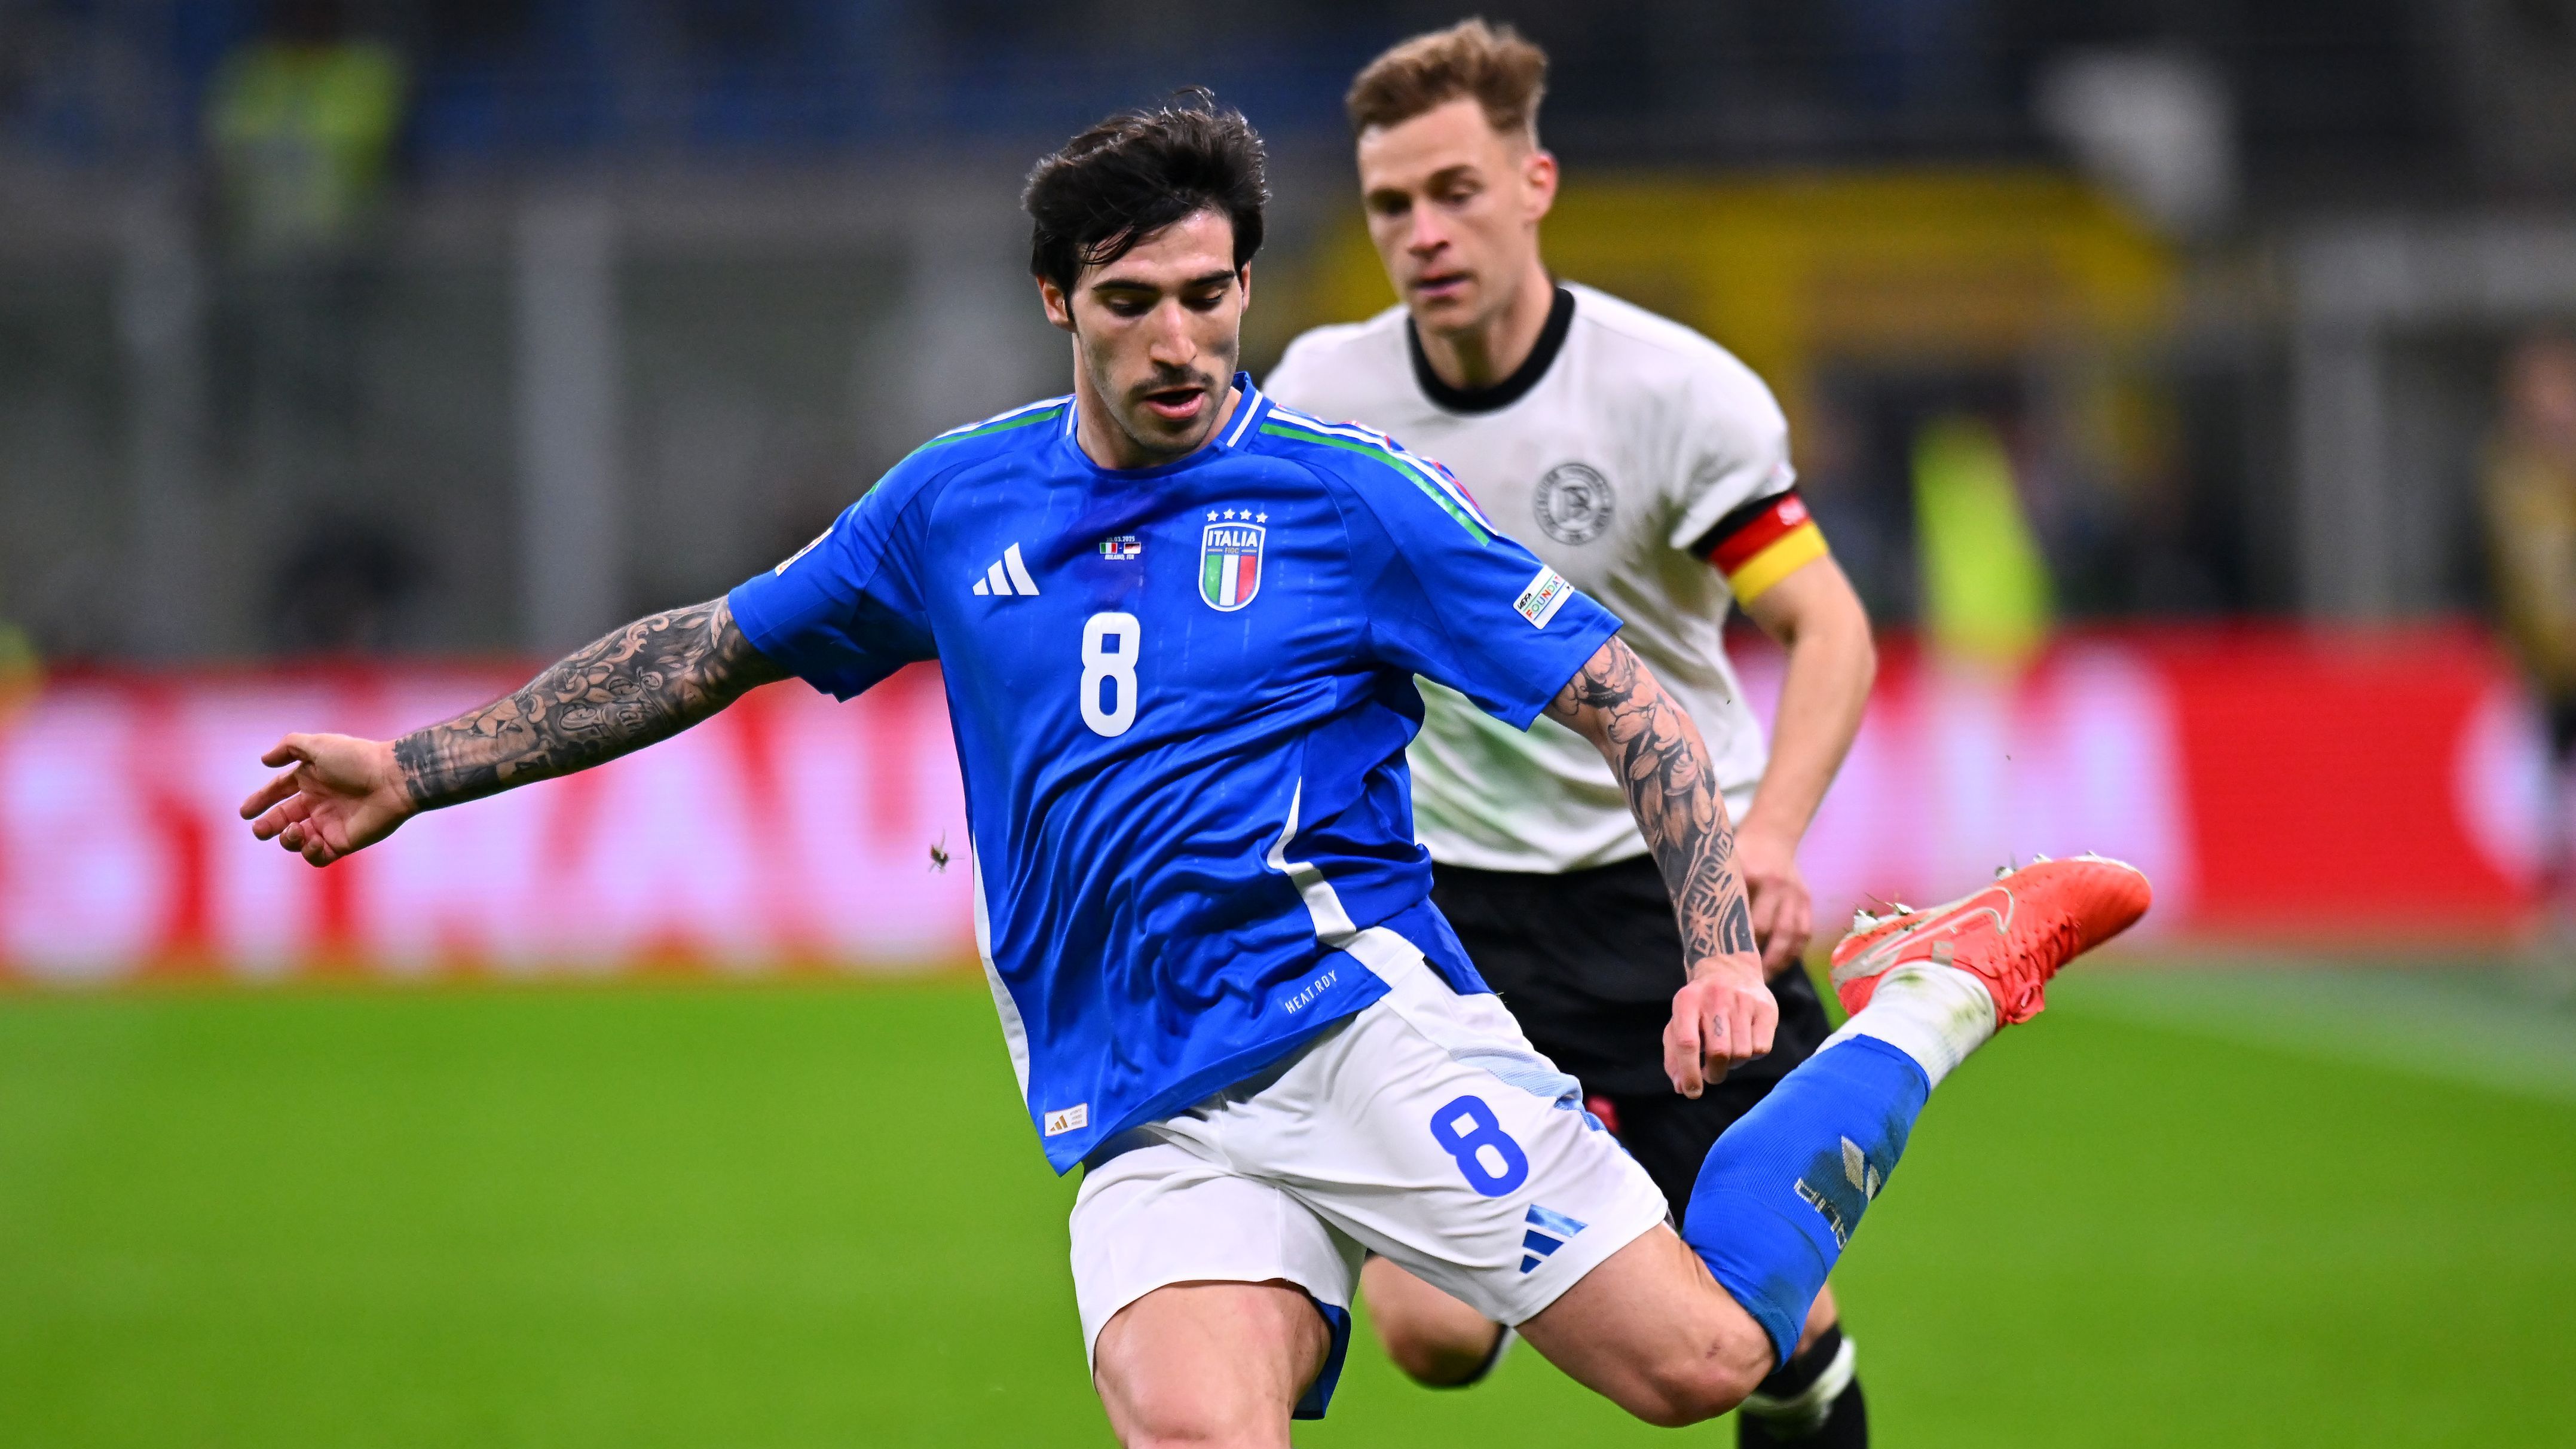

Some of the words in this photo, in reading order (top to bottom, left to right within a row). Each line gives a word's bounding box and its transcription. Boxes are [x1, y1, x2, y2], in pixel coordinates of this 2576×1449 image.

[1207, 530, 1258, 547] ITALIA
[1517, 593, 1532, 610] UEFA
[1080, 612, 1140, 737] 8
[1284, 969, 1337, 1014] HEAT.RDY
[1430, 1095, 1528, 1197] 8
